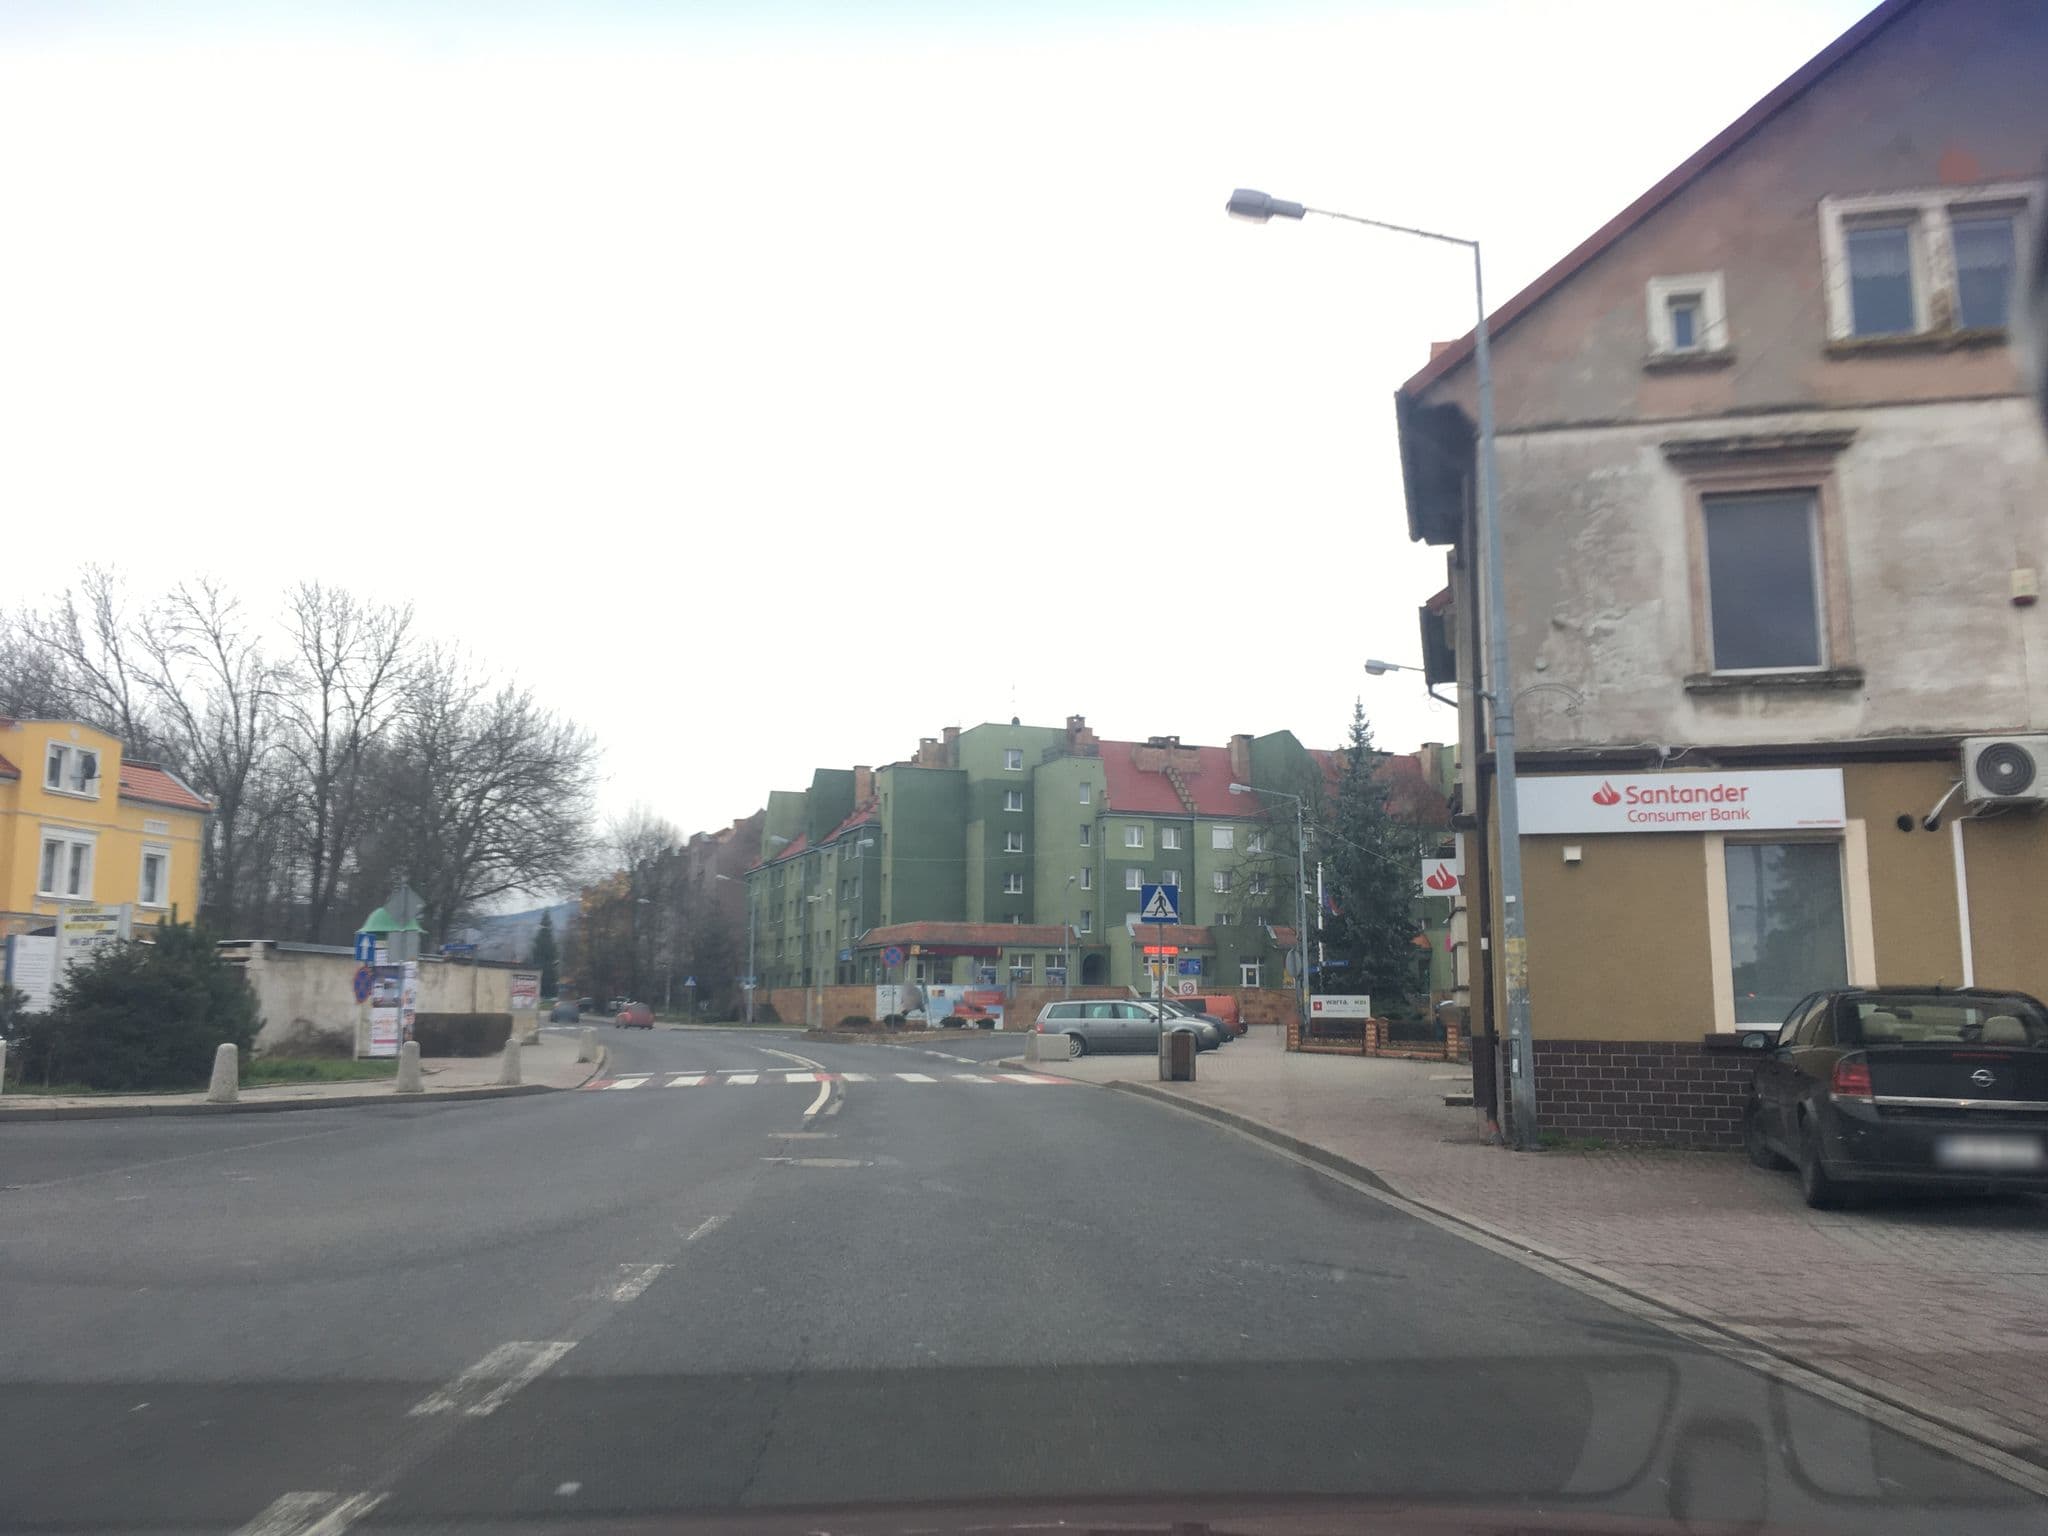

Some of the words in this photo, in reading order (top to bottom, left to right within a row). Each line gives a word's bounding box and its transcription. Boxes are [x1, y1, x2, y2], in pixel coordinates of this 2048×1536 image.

[1626, 784, 1748, 804] Santander
[1628, 809, 1707, 823] Consumer
[1711, 807, 1750, 820] Bank
